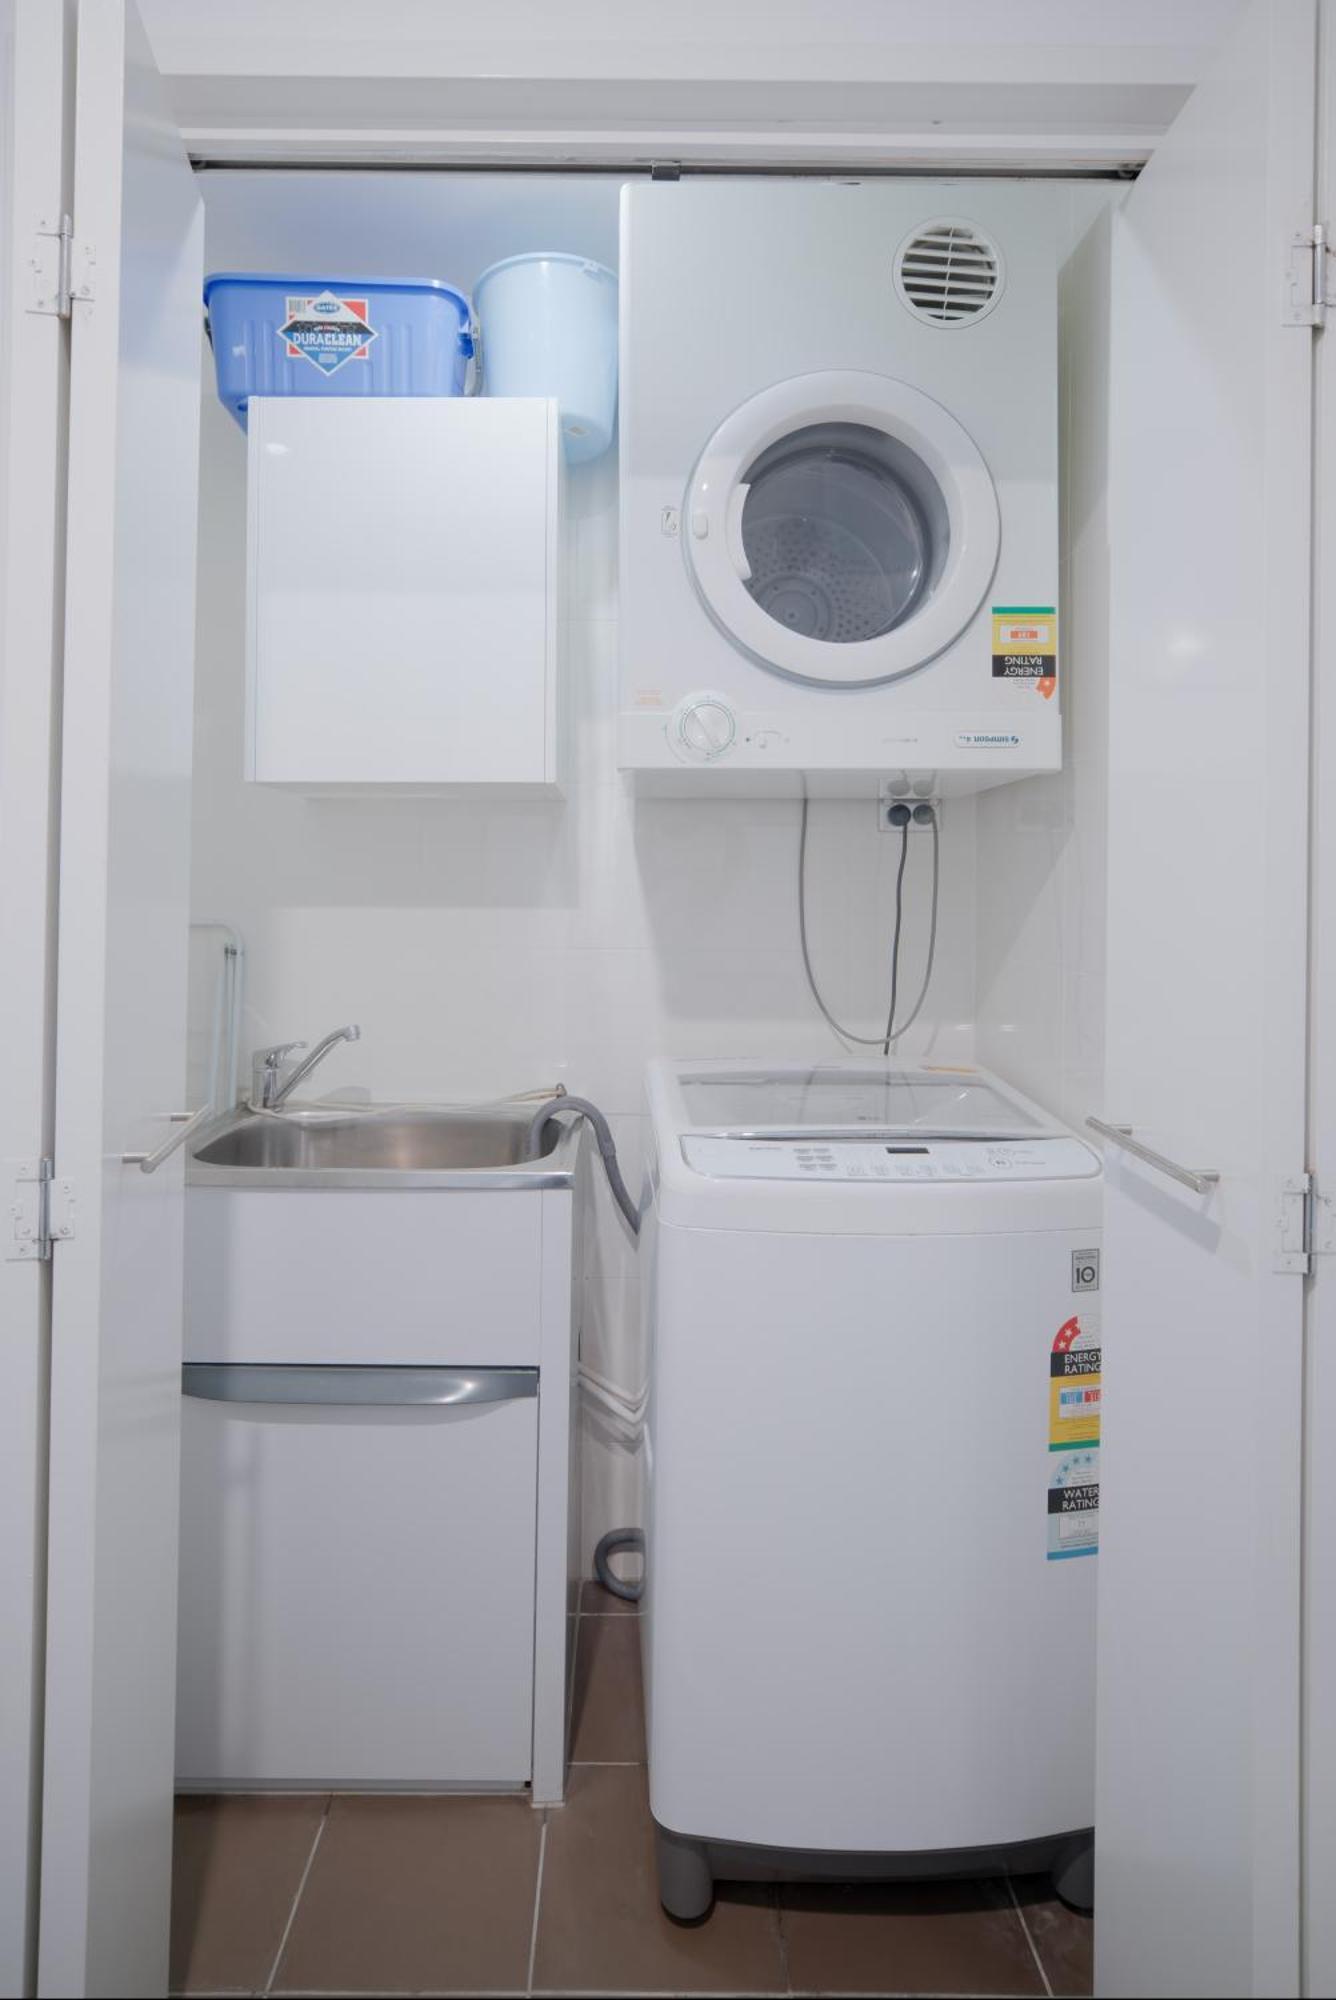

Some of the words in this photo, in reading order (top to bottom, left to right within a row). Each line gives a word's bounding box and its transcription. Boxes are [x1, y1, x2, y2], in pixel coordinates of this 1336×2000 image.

[292, 332, 362, 346] DURACLEAN
[1004, 656, 1042, 665] RATING
[1003, 666, 1044, 676] ENERGY
[1076, 1266, 1096, 1284] 10
[1064, 1351, 1101, 1364] ENERGY
